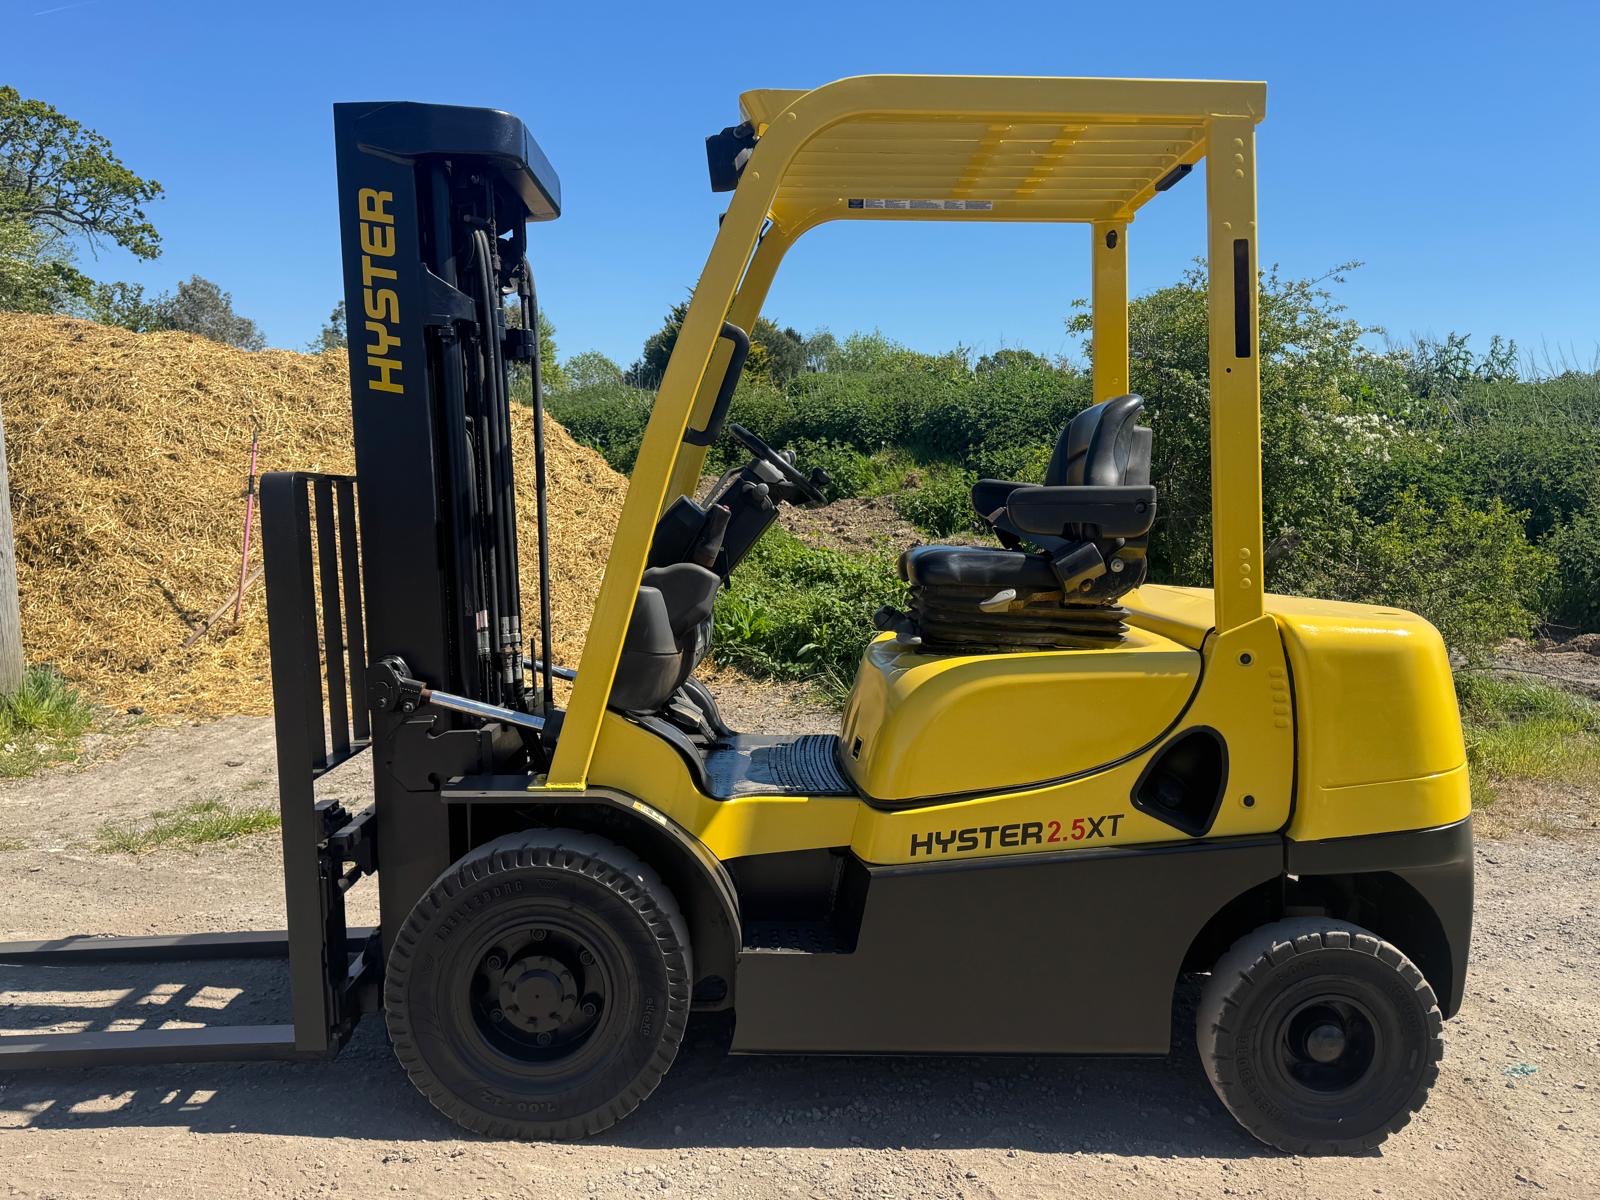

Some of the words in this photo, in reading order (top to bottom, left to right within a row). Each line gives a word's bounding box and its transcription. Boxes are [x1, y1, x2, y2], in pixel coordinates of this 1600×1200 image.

[358, 188, 404, 394] HYSTER
[910, 822, 1043, 857] HYSTER
[1047, 814, 1125, 842] 2.5XT
[433, 879, 524, 943] TRELLEBORG
